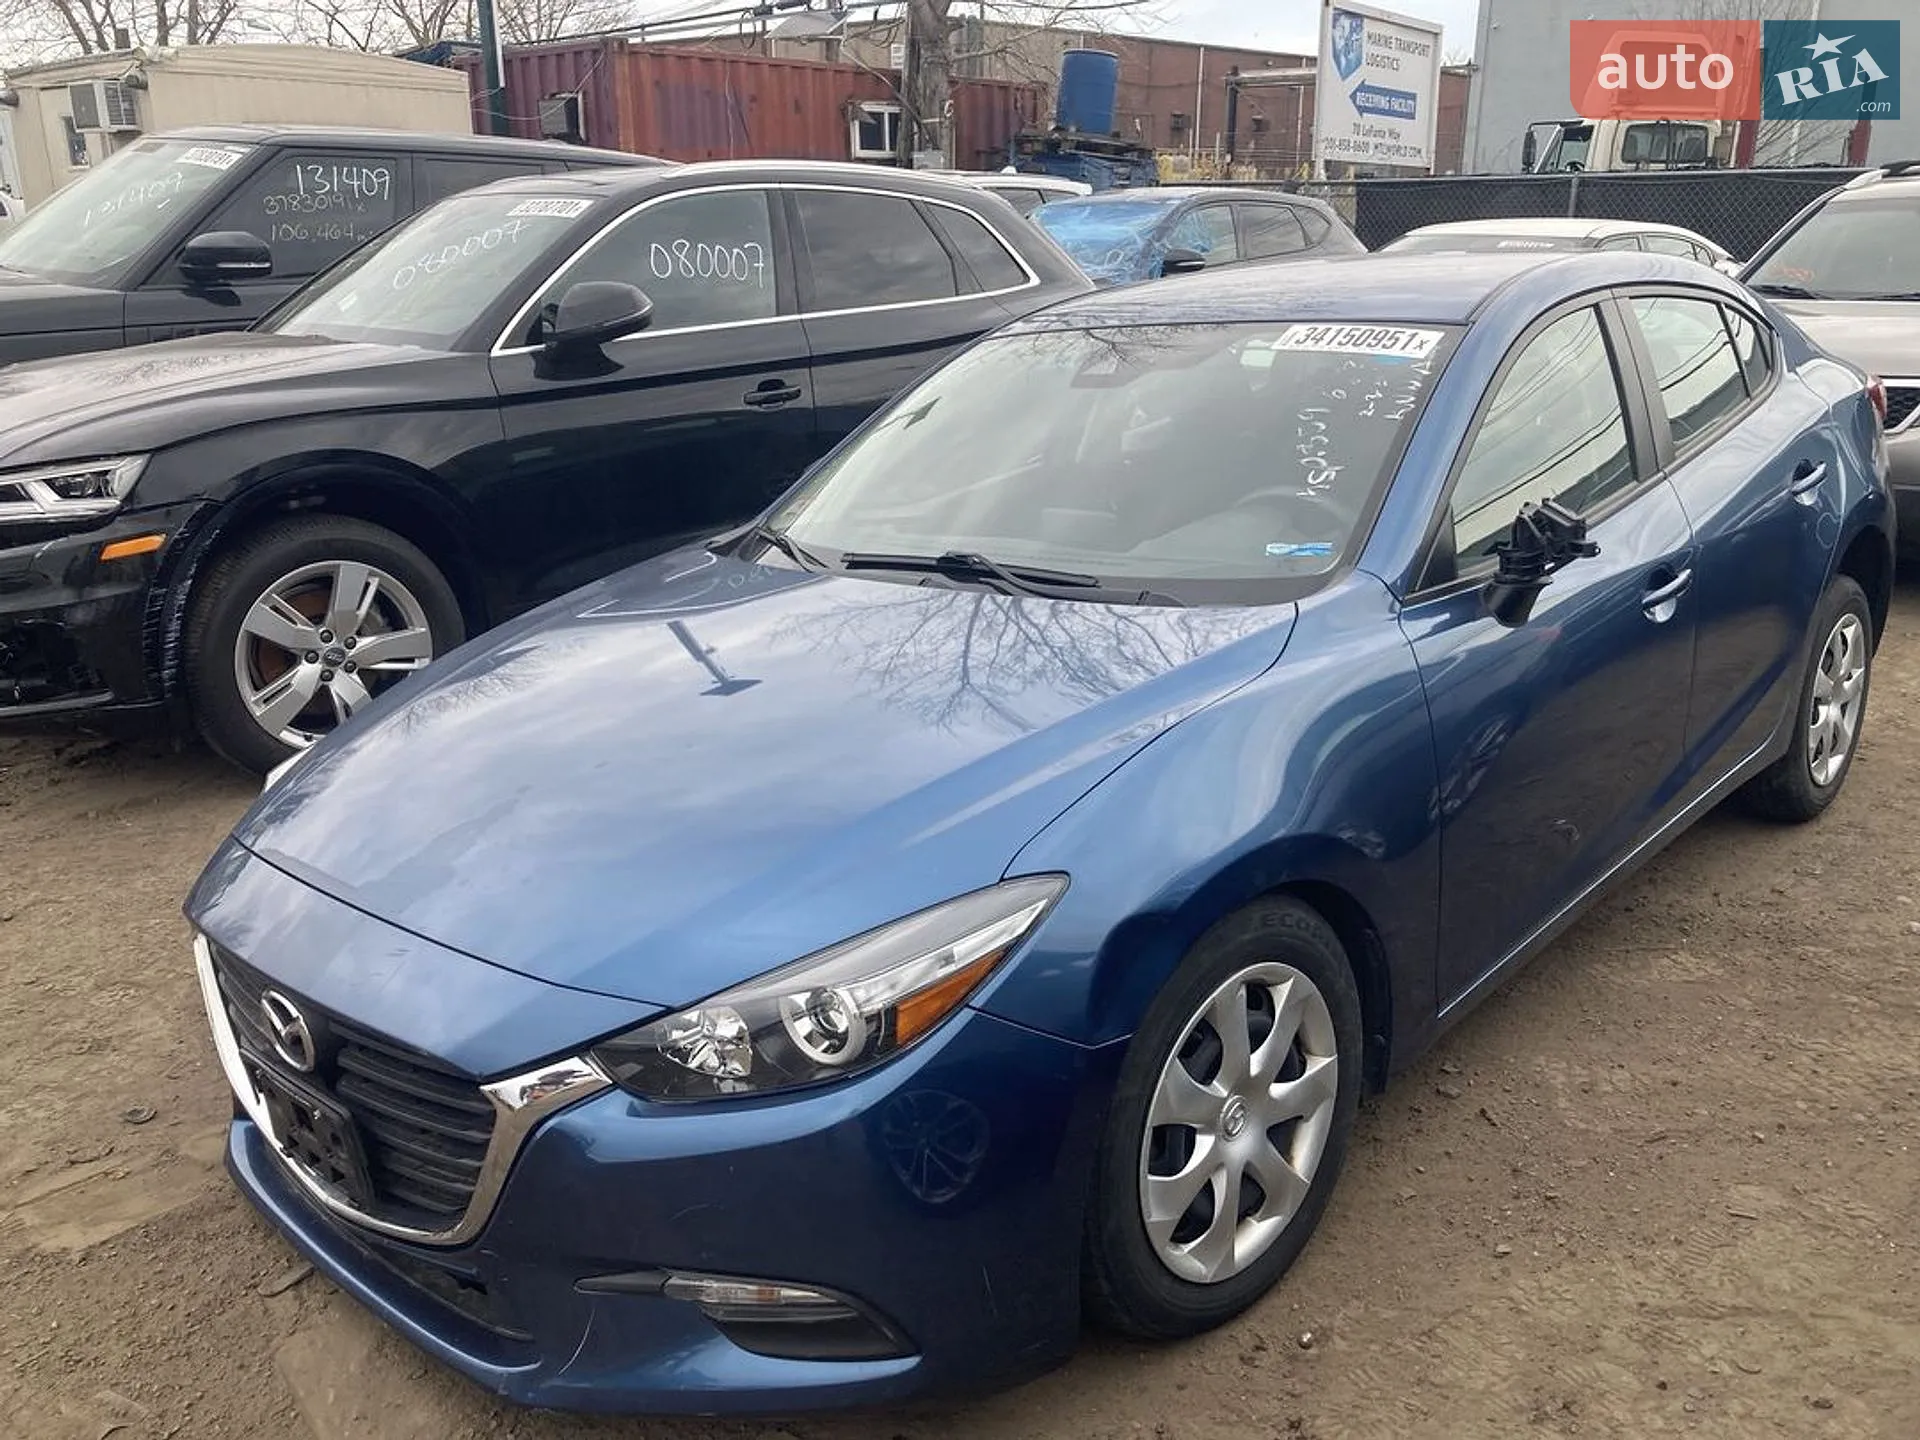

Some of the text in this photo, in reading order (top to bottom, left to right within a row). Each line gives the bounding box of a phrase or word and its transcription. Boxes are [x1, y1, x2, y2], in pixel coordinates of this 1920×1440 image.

[1367, 32, 1393, 49] MARINE
[1394, 36, 1430, 58] TRANSPORT
[1365, 52, 1400, 71] LOGISTICS
[1356, 92, 1391, 110] RECEIVING
[296, 164, 391, 201] 131409
[649, 238, 765, 289] 080007
